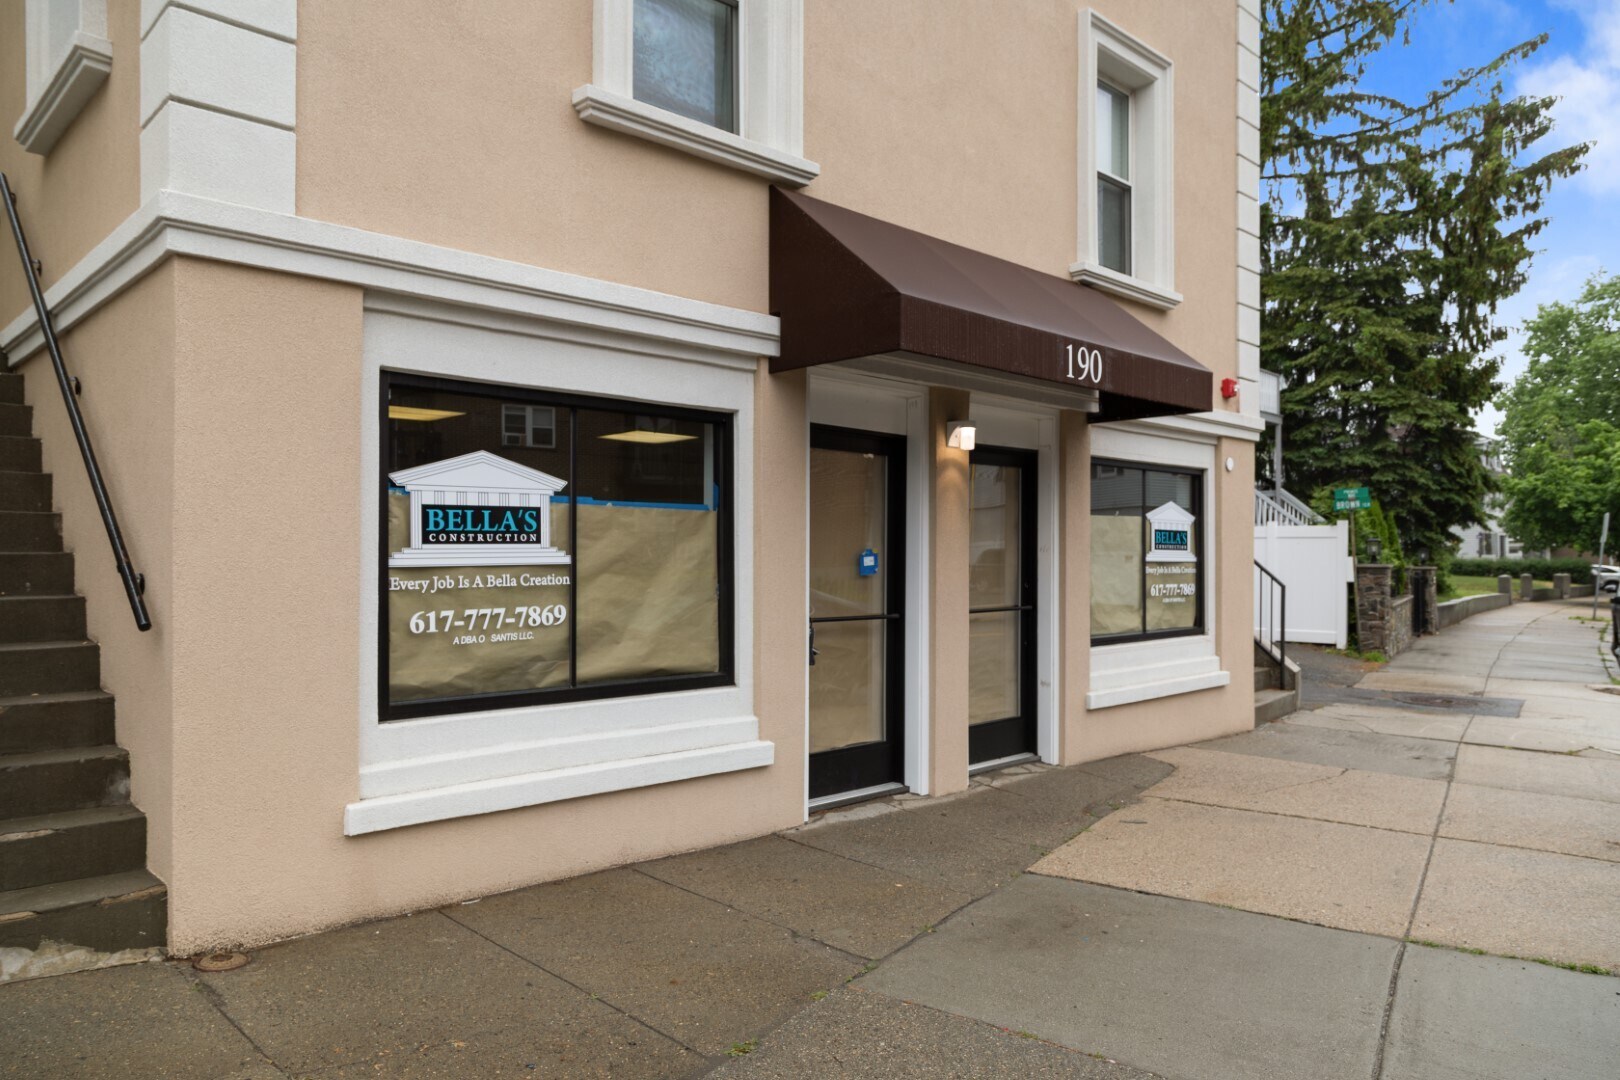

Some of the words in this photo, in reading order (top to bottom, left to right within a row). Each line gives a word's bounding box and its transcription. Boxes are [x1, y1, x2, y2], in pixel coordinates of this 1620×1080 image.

[1065, 344, 1103, 384] 190
[426, 508, 538, 532] BELLA'S
[429, 533, 537, 542] CONSTRUCTION
[1156, 531, 1187, 545] BELLA'S
[389, 577, 430, 593] Every
[430, 576, 455, 593] Job
[458, 575, 470, 589] Is
[472, 575, 484, 588] A
[486, 574, 517, 587] Bella
[520, 573, 571, 586] Creation
[1150, 583, 1196, 597] 617-777-7869
[409, 604, 567, 634] 617-777-7869
[490, 632, 518, 642] SANTIS
